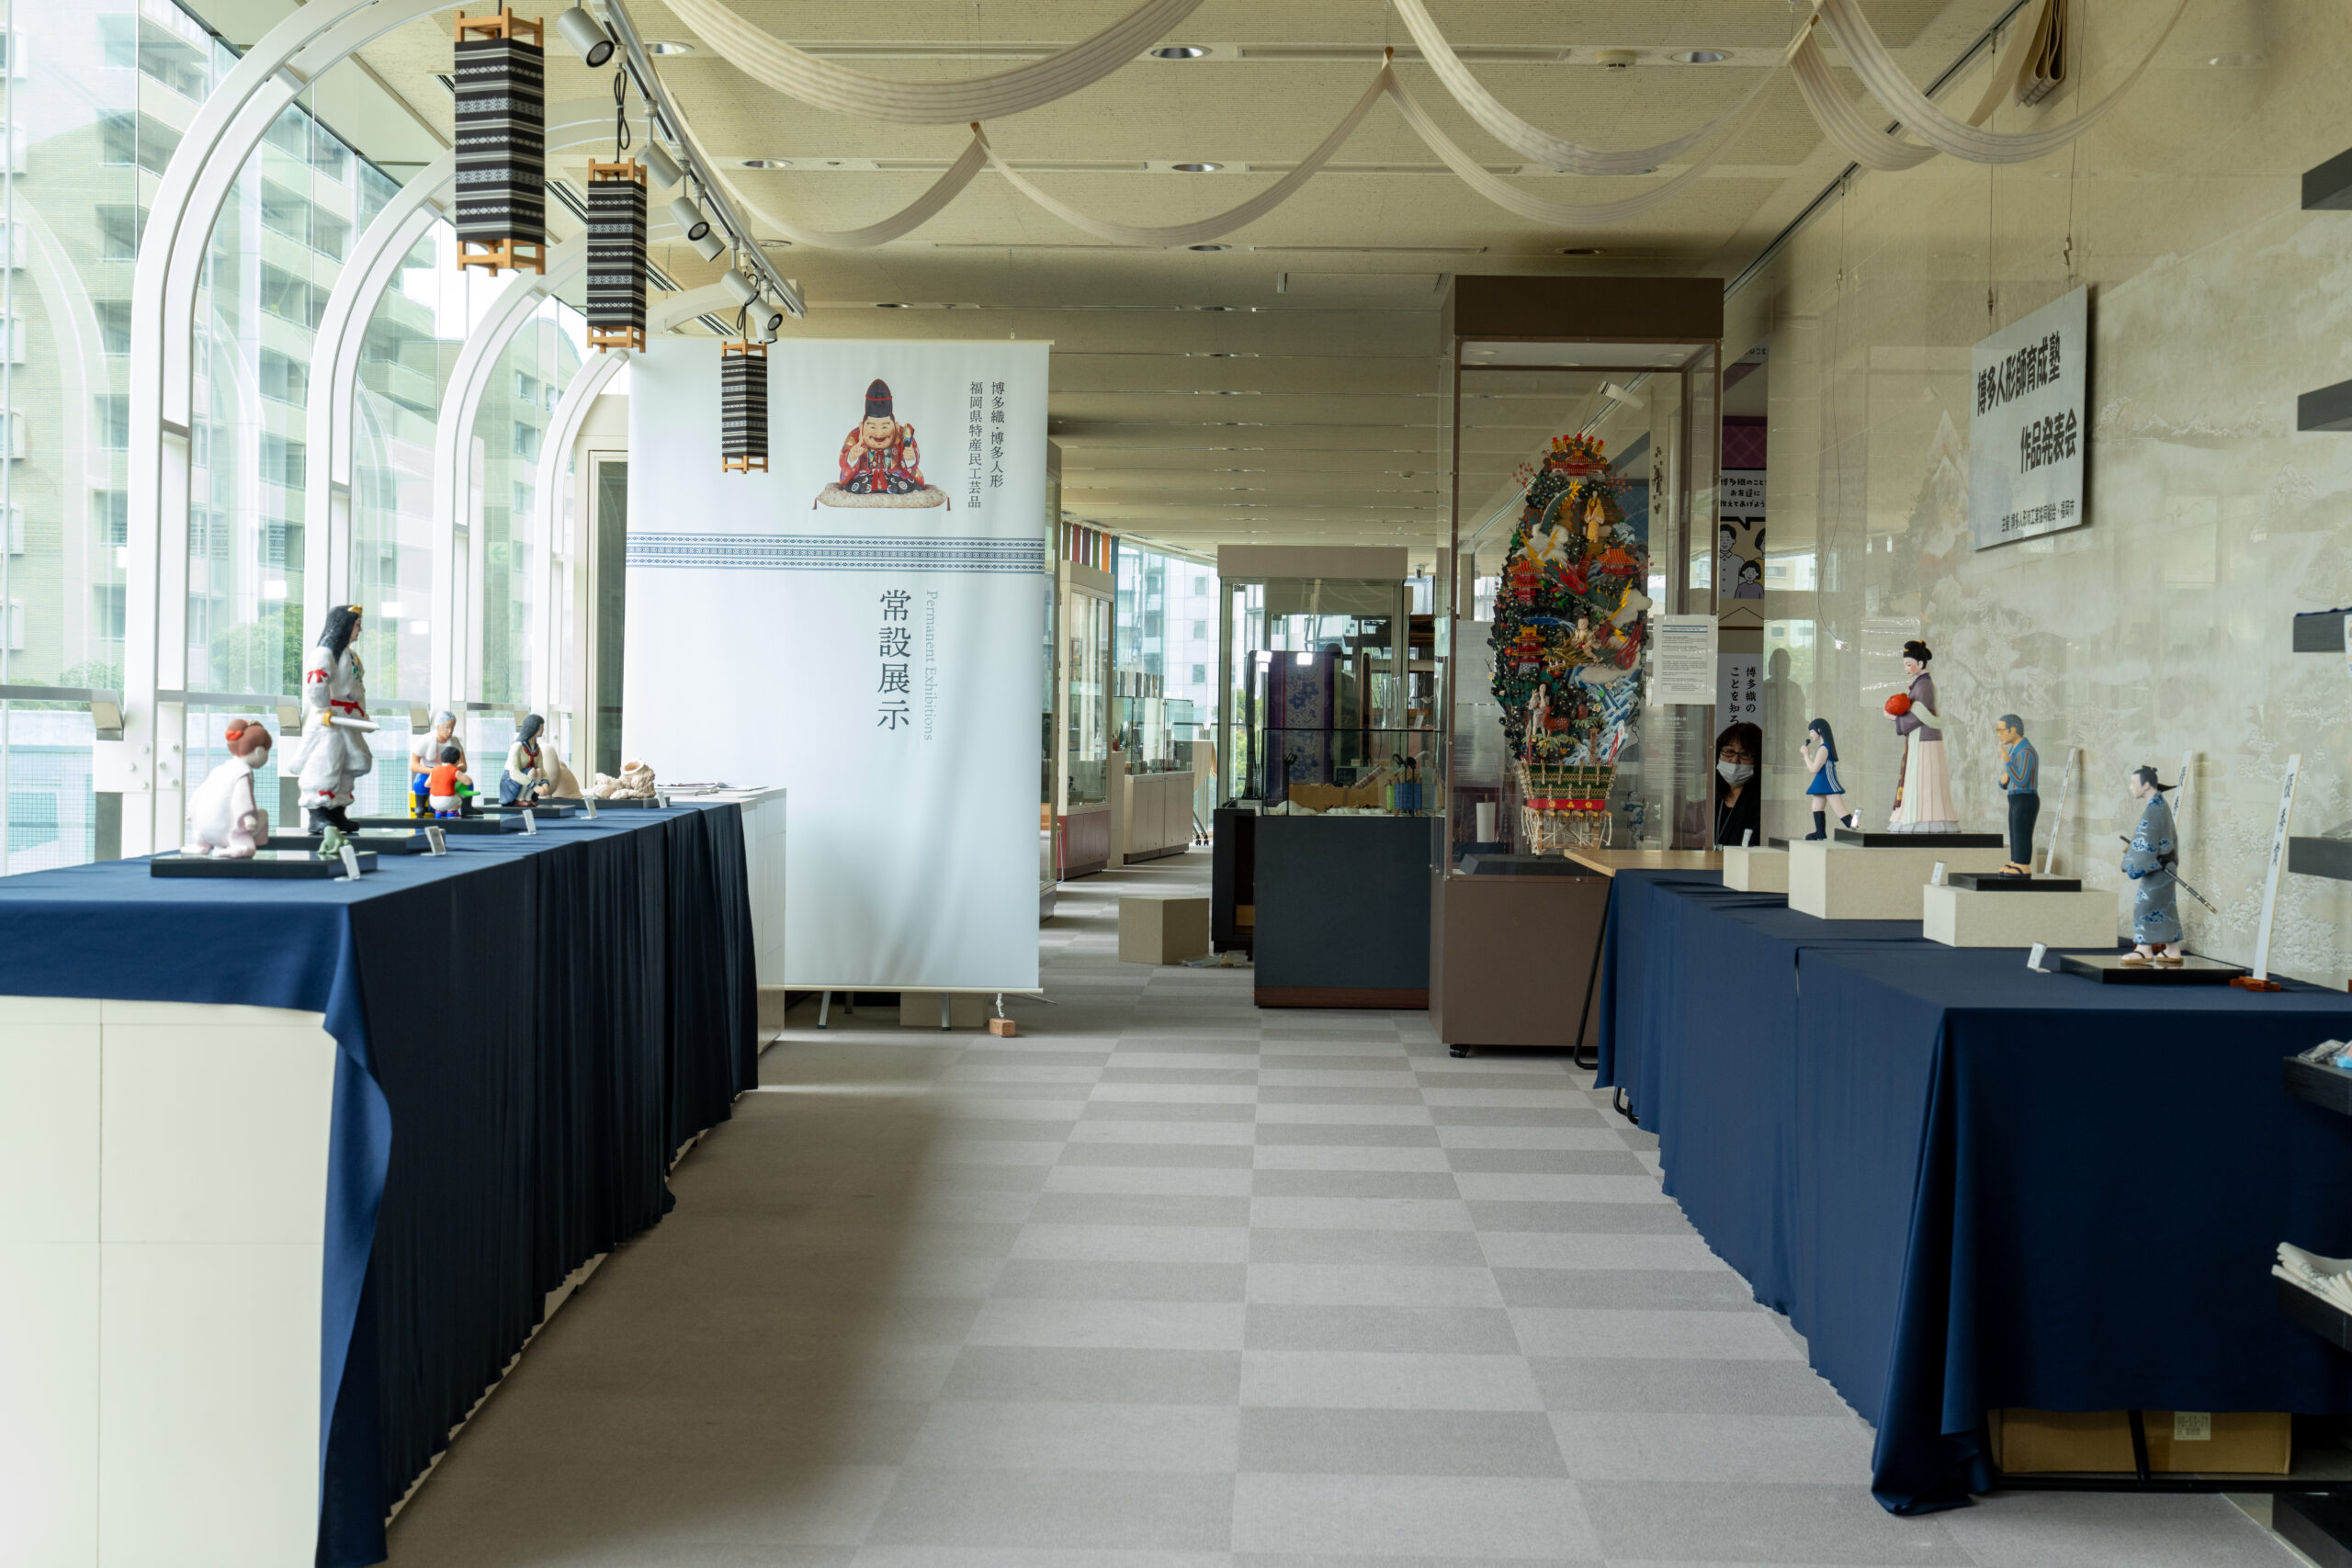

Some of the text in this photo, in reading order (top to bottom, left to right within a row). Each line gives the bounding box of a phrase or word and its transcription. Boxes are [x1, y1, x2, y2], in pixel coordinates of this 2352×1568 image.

[1977, 331, 2060, 416] 博多人形師育成塾
[967, 381, 983, 508] 福岡県特産民工芸品
[989, 381, 1005, 488] 博多織・博多人形
[2020, 408, 2077, 474] 作品発表会
[1730, 489, 1760, 497] お友達に
[877, 590, 911, 730] 常設展示
[924, 591, 939, 740] Permanent Exhibitions
[1746, 666, 1757, 713] 博多織の
